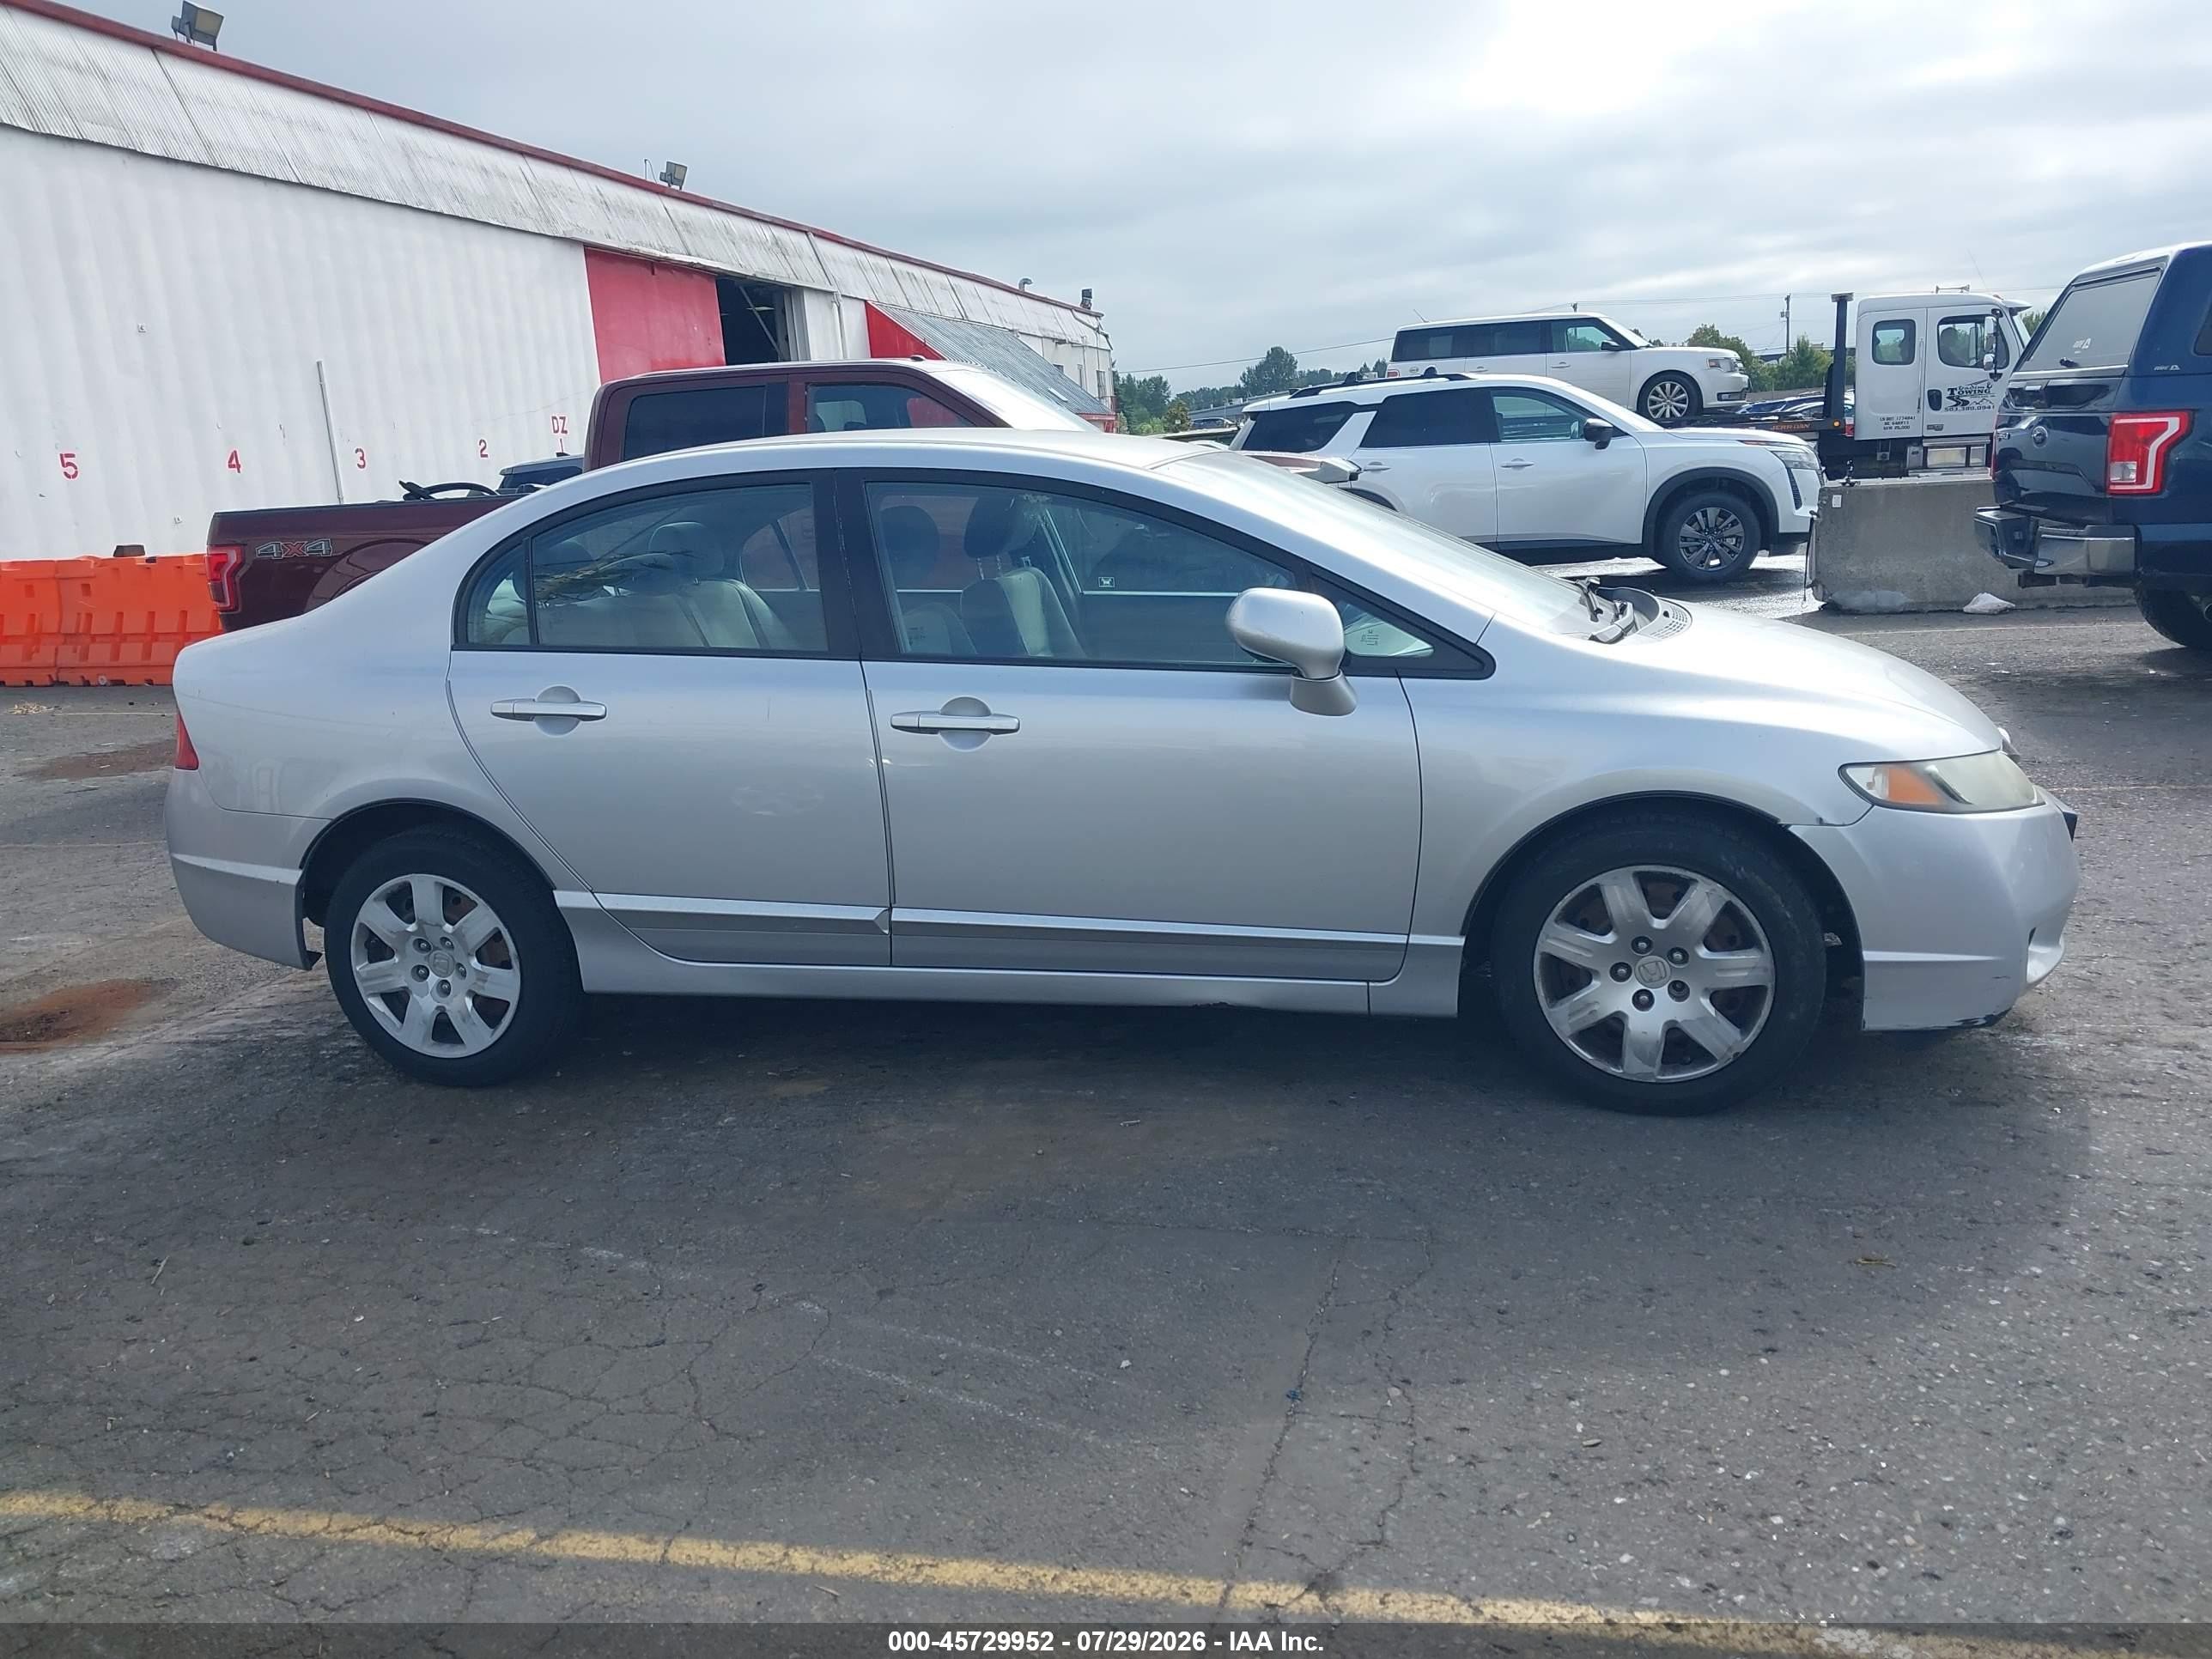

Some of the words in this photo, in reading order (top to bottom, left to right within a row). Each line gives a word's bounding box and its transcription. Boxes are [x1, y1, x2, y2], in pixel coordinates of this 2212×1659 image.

[1948, 387, 1991, 396] TOWING
[551, 416, 568, 434] DZ
[355, 447, 366, 469] 3
[478, 439, 489, 459] 2
[59, 453, 79, 480] 5
[227, 449, 241, 474] 4
